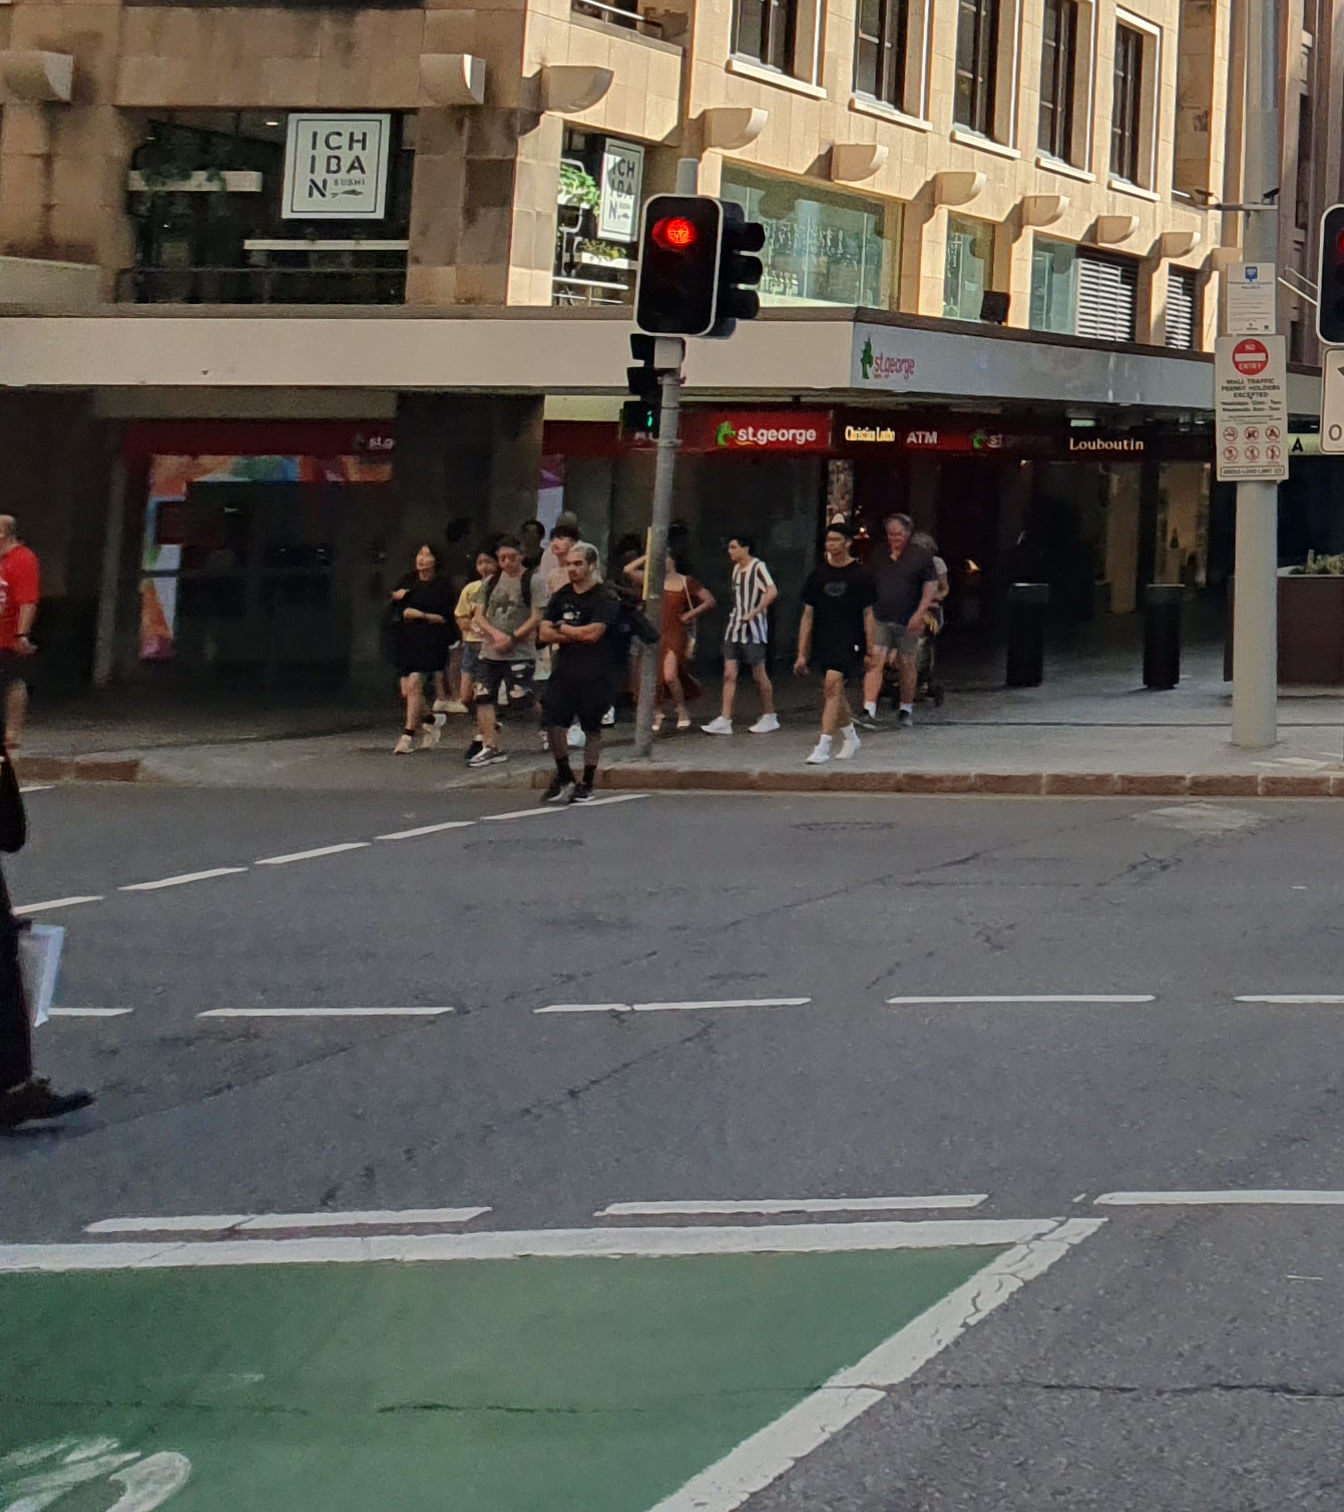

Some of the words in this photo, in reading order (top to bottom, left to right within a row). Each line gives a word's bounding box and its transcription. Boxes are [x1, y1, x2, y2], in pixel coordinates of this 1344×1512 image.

[311, 131, 367, 151] ICH
[310, 155, 366, 175] IBA
[612, 157, 636, 178] ICH
[308, 178, 327, 199] N
[738, 426, 817, 445] st.george
[906, 431, 938, 444] ATM
[1069, 438, 1144, 451] Louboutin
